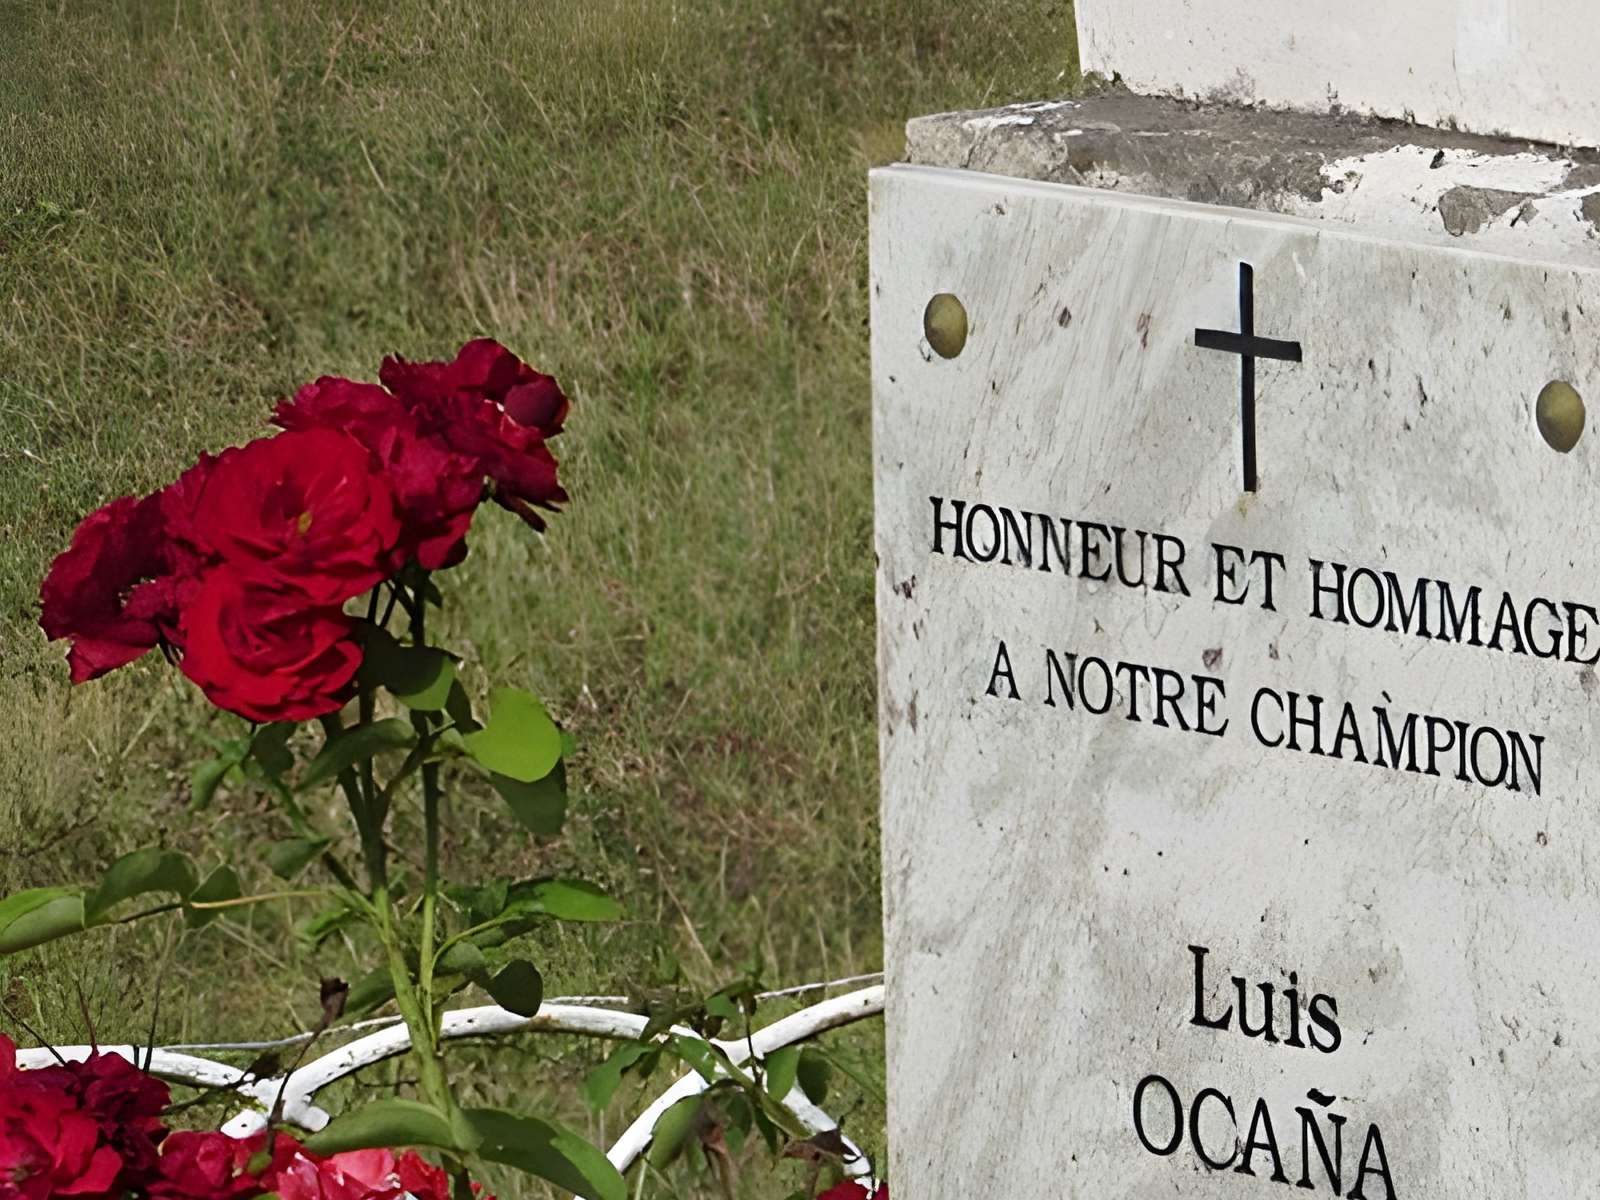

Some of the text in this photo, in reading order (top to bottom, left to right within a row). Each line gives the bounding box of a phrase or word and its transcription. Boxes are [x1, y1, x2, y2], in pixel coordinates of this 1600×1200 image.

[928, 496, 1191, 597] HONNEUR
[1211, 544, 1286, 611] ET
[985, 640, 1545, 796] A NOTRE CHAMPION
[1187, 944, 1342, 1053] Luis
